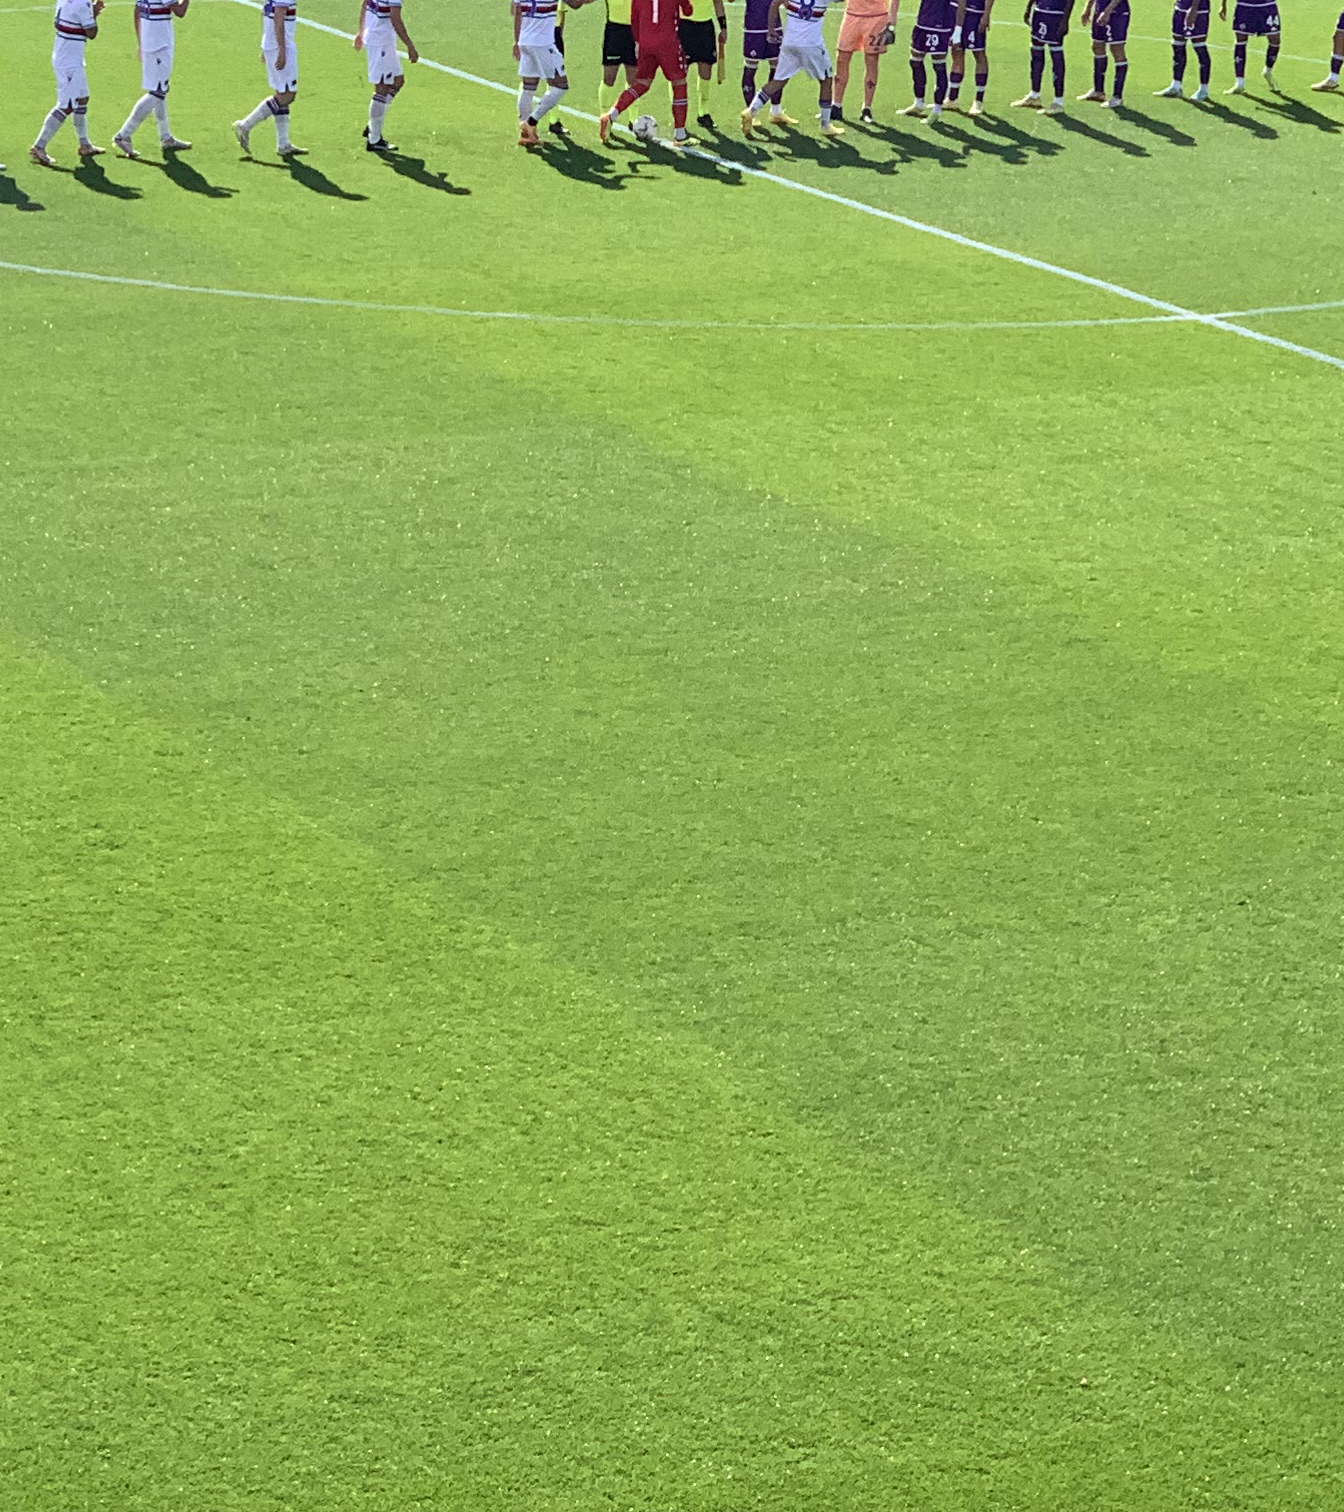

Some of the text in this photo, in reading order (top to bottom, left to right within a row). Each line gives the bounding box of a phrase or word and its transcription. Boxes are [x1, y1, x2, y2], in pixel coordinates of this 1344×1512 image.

[1266, 14, 1280, 27] 44
[925, 33, 940, 47] 29
[968, 30, 976, 43] 4
